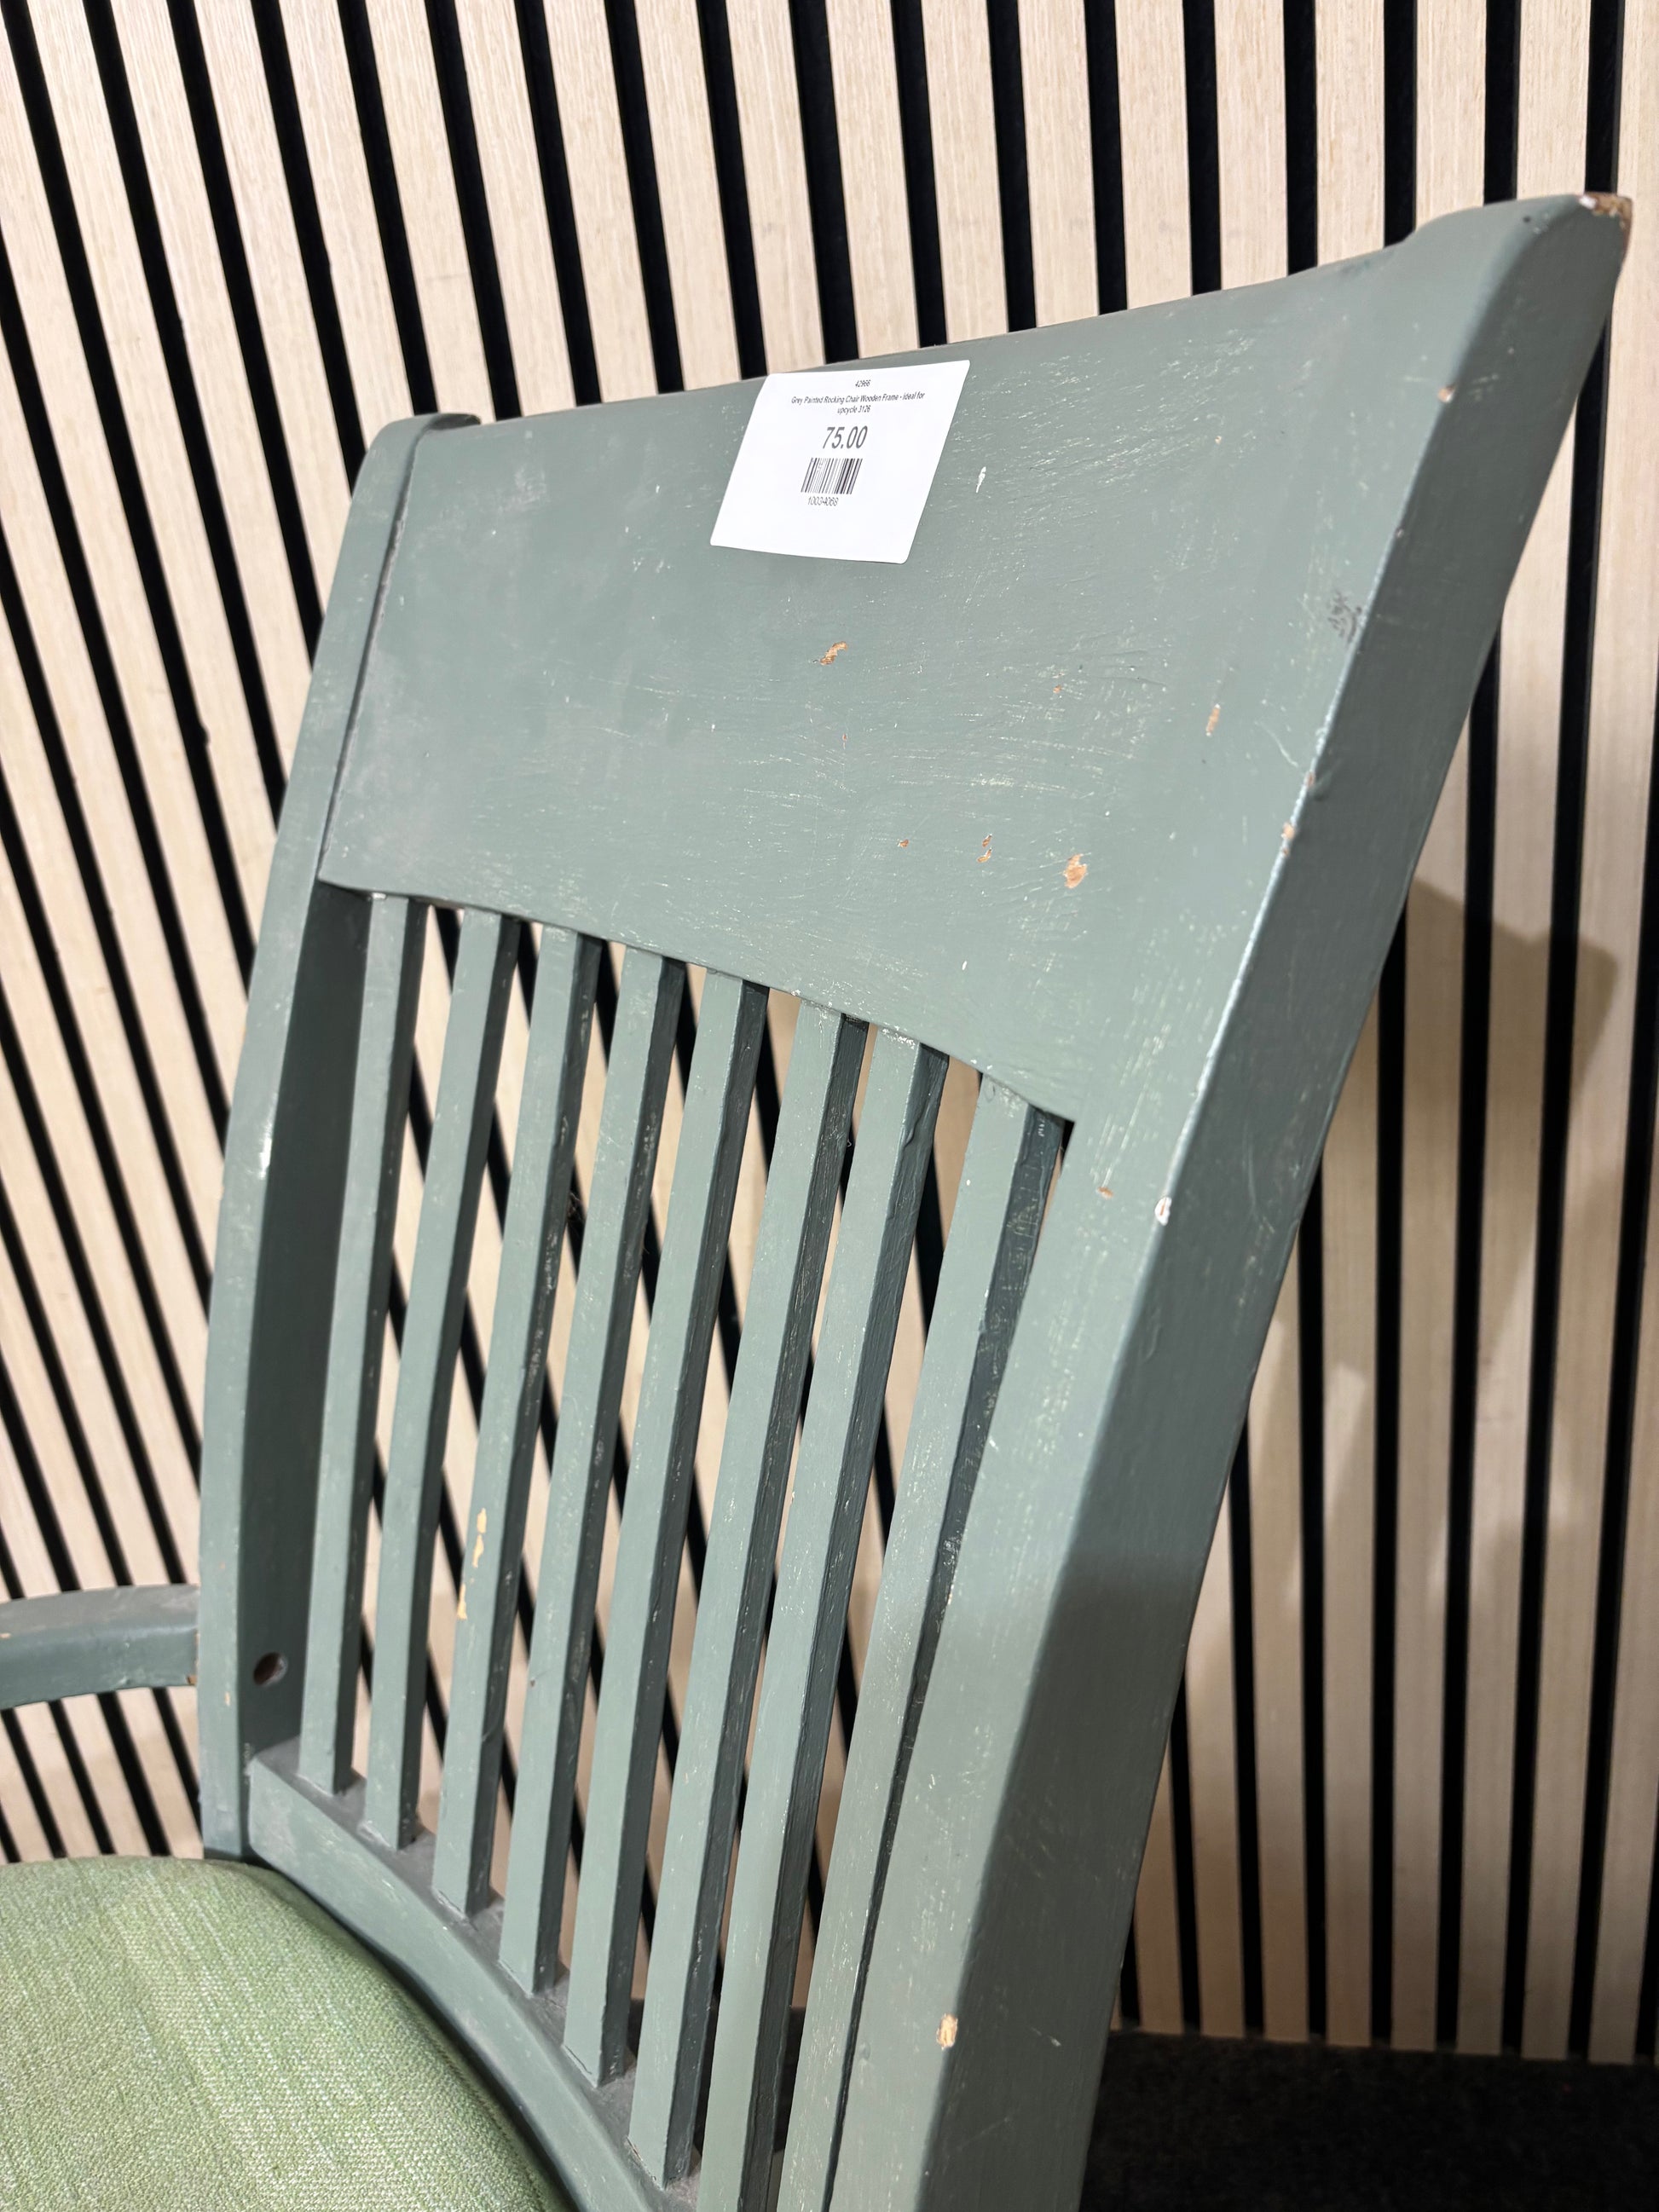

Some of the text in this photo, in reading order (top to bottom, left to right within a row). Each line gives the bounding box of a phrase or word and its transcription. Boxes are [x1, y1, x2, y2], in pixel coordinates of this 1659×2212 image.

[791, 396, 803, 406] Grey
[803, 396, 824, 404] Painted
[824, 395, 845, 405] Rocking
[845, 395, 860, 403] Chair
[860, 394, 882, 402] Wooden
[882, 393, 899, 401] Frame
[916, 390, 926, 400] for
[837, 405, 858, 415] upcycle
[823, 425, 868, 449] 75.00
